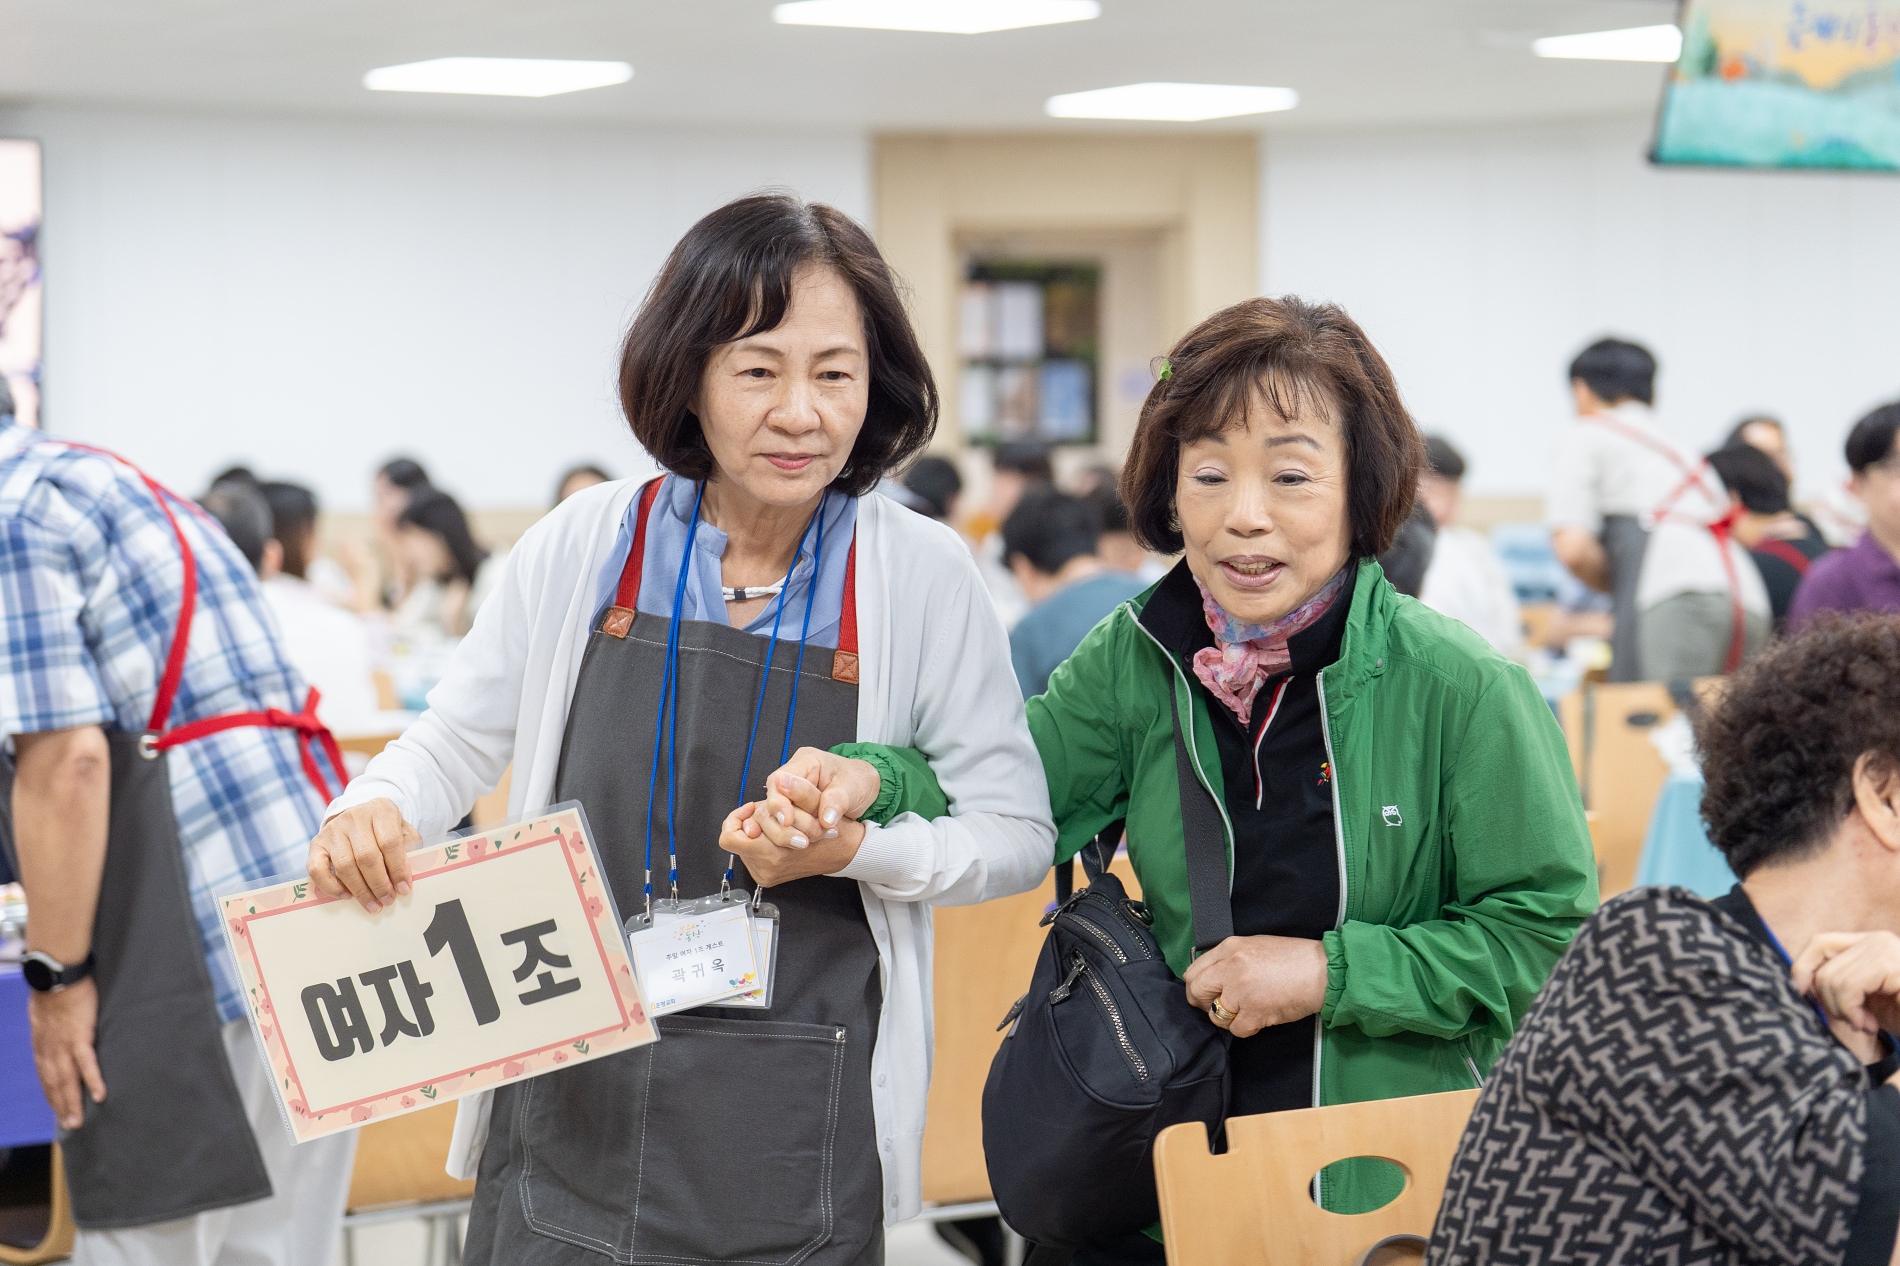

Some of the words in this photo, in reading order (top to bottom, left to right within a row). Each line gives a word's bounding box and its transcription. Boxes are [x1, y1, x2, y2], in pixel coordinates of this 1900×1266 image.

[666, 952, 678, 961] 주일
[680, 948, 692, 957] 여자
[694, 946, 704, 954] 1조
[705, 940, 724, 950] 게스트
